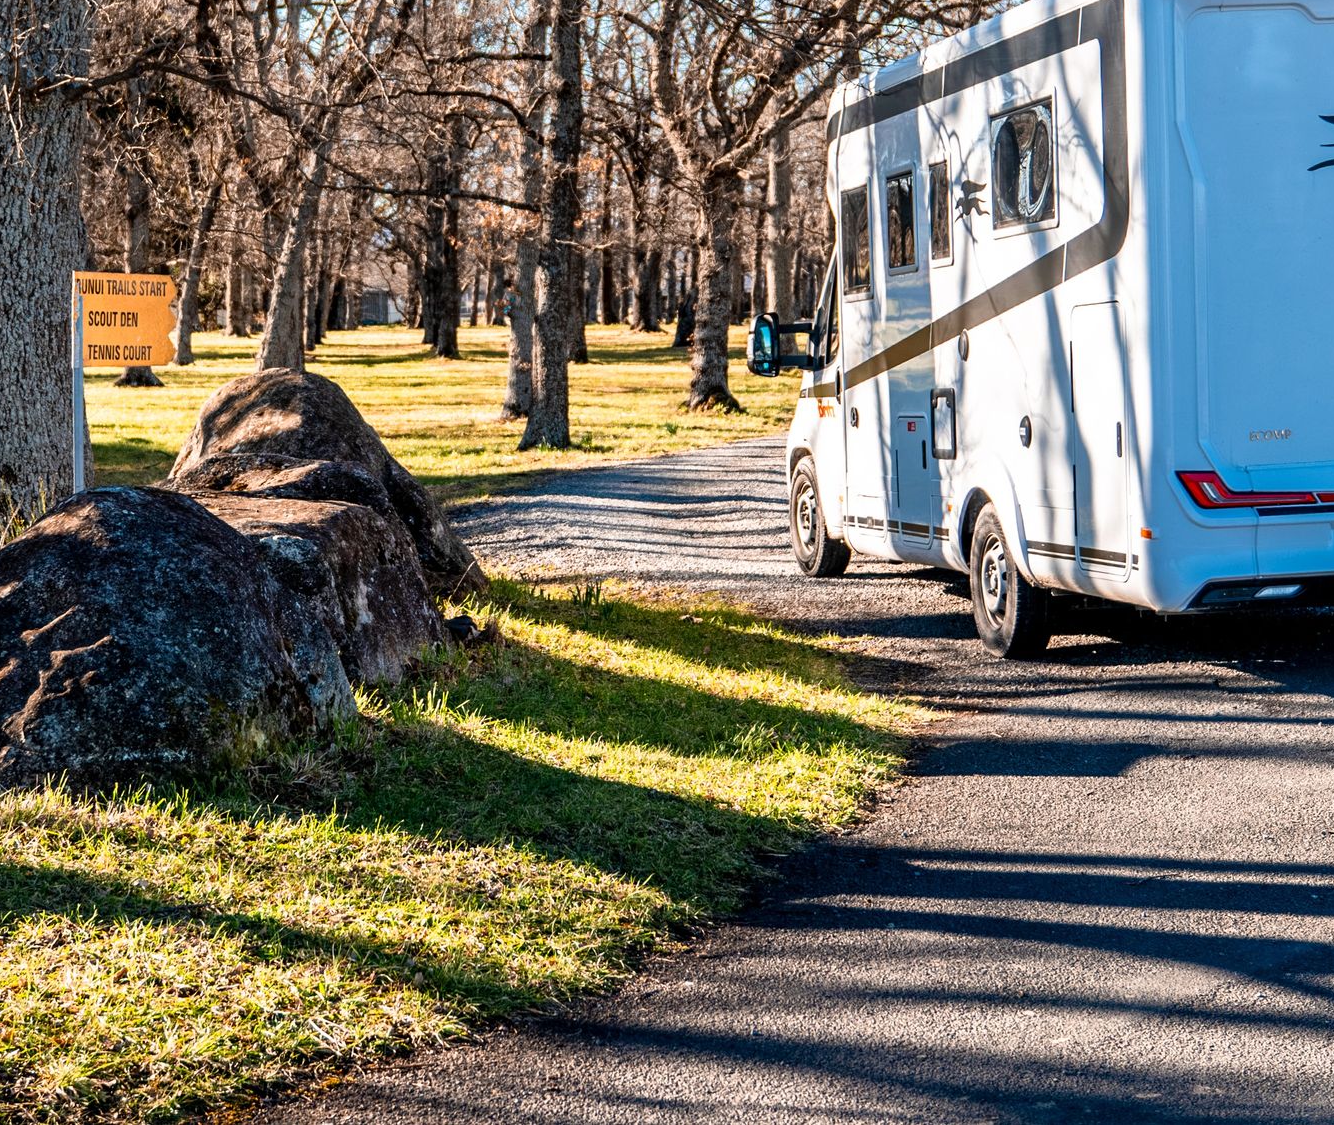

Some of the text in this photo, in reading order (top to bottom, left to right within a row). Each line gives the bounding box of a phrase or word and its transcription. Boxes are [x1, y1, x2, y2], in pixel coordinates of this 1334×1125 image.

[107, 279, 137, 296] TRAILS
[139, 281, 167, 297] START
[88, 311, 138, 327] SCOUT DEN
[88, 344, 152, 361] TENNIS COURT
